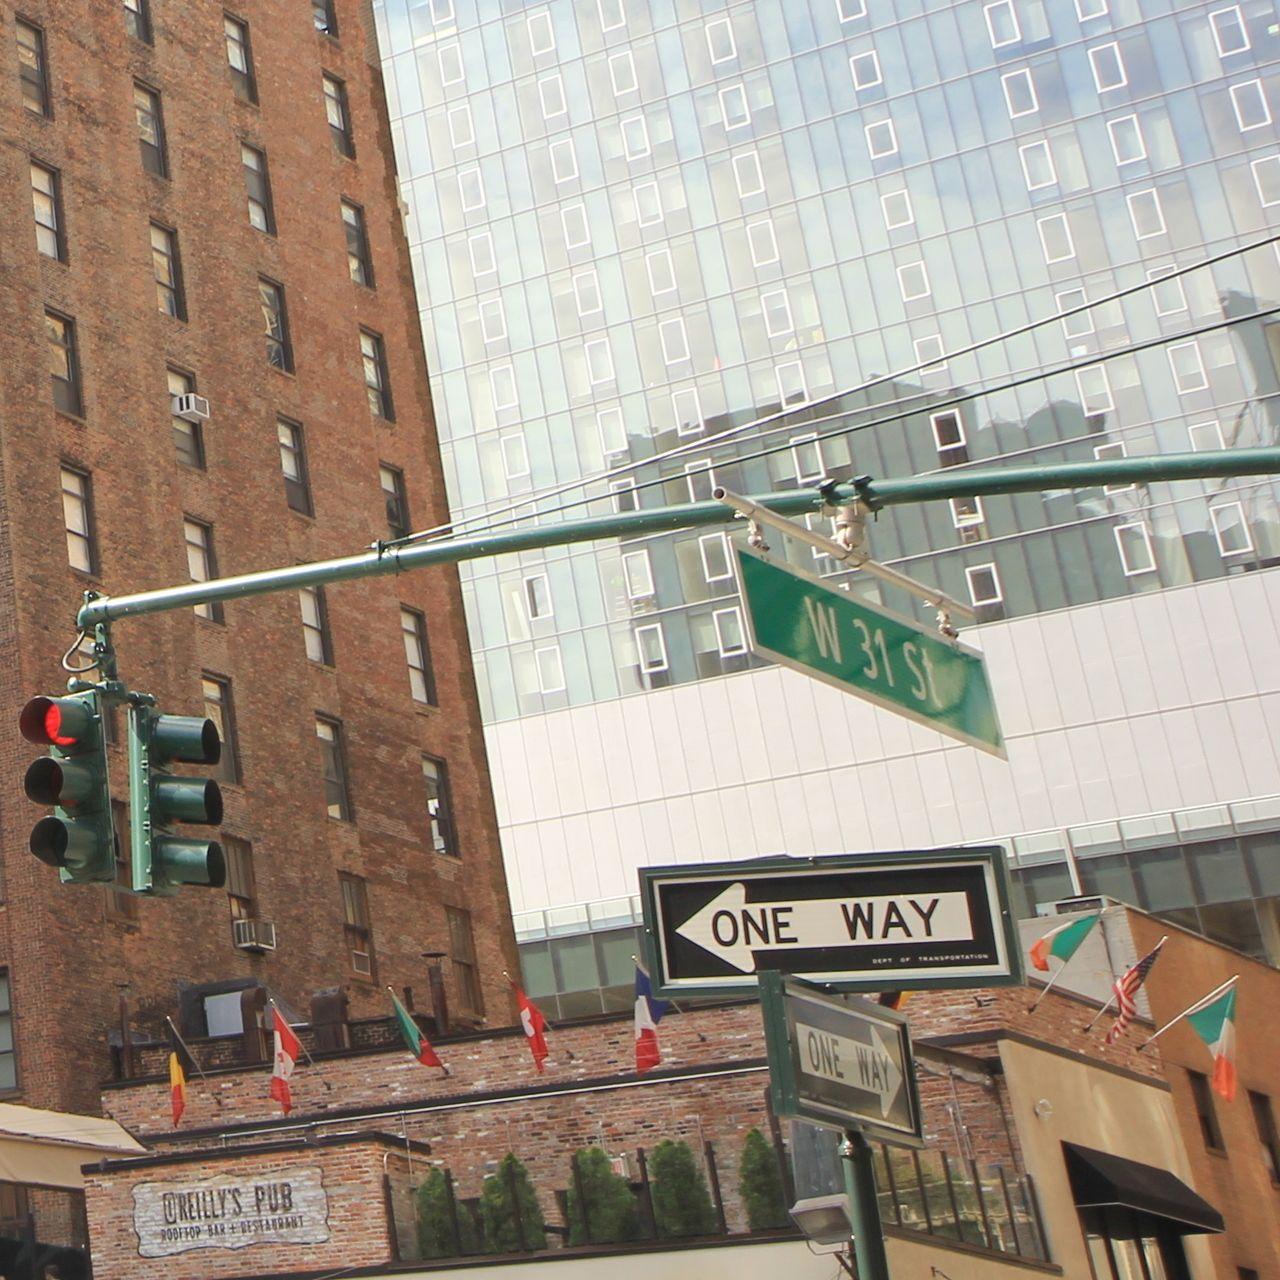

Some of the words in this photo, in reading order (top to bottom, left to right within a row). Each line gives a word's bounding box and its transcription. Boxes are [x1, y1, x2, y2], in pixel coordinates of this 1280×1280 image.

[804, 596, 842, 665] W
[852, 618, 895, 688] 31
[902, 641, 945, 710] St
[711, 906, 799, 948] ONE
[840, 898, 940, 941] WAY
[871, 957, 893, 965] DEPT
[918, 952, 990, 963] TRANSPORTATION
[807, 1030, 845, 1079] ONE
[855, 1045, 890, 1093] WAY
[254, 1182, 294, 1215] PUB
[161, 1226, 201, 1242] ROOFTOP
[208, 1223, 225, 1237] BAR
[241, 1215, 305, 1234] RESTAURANT
